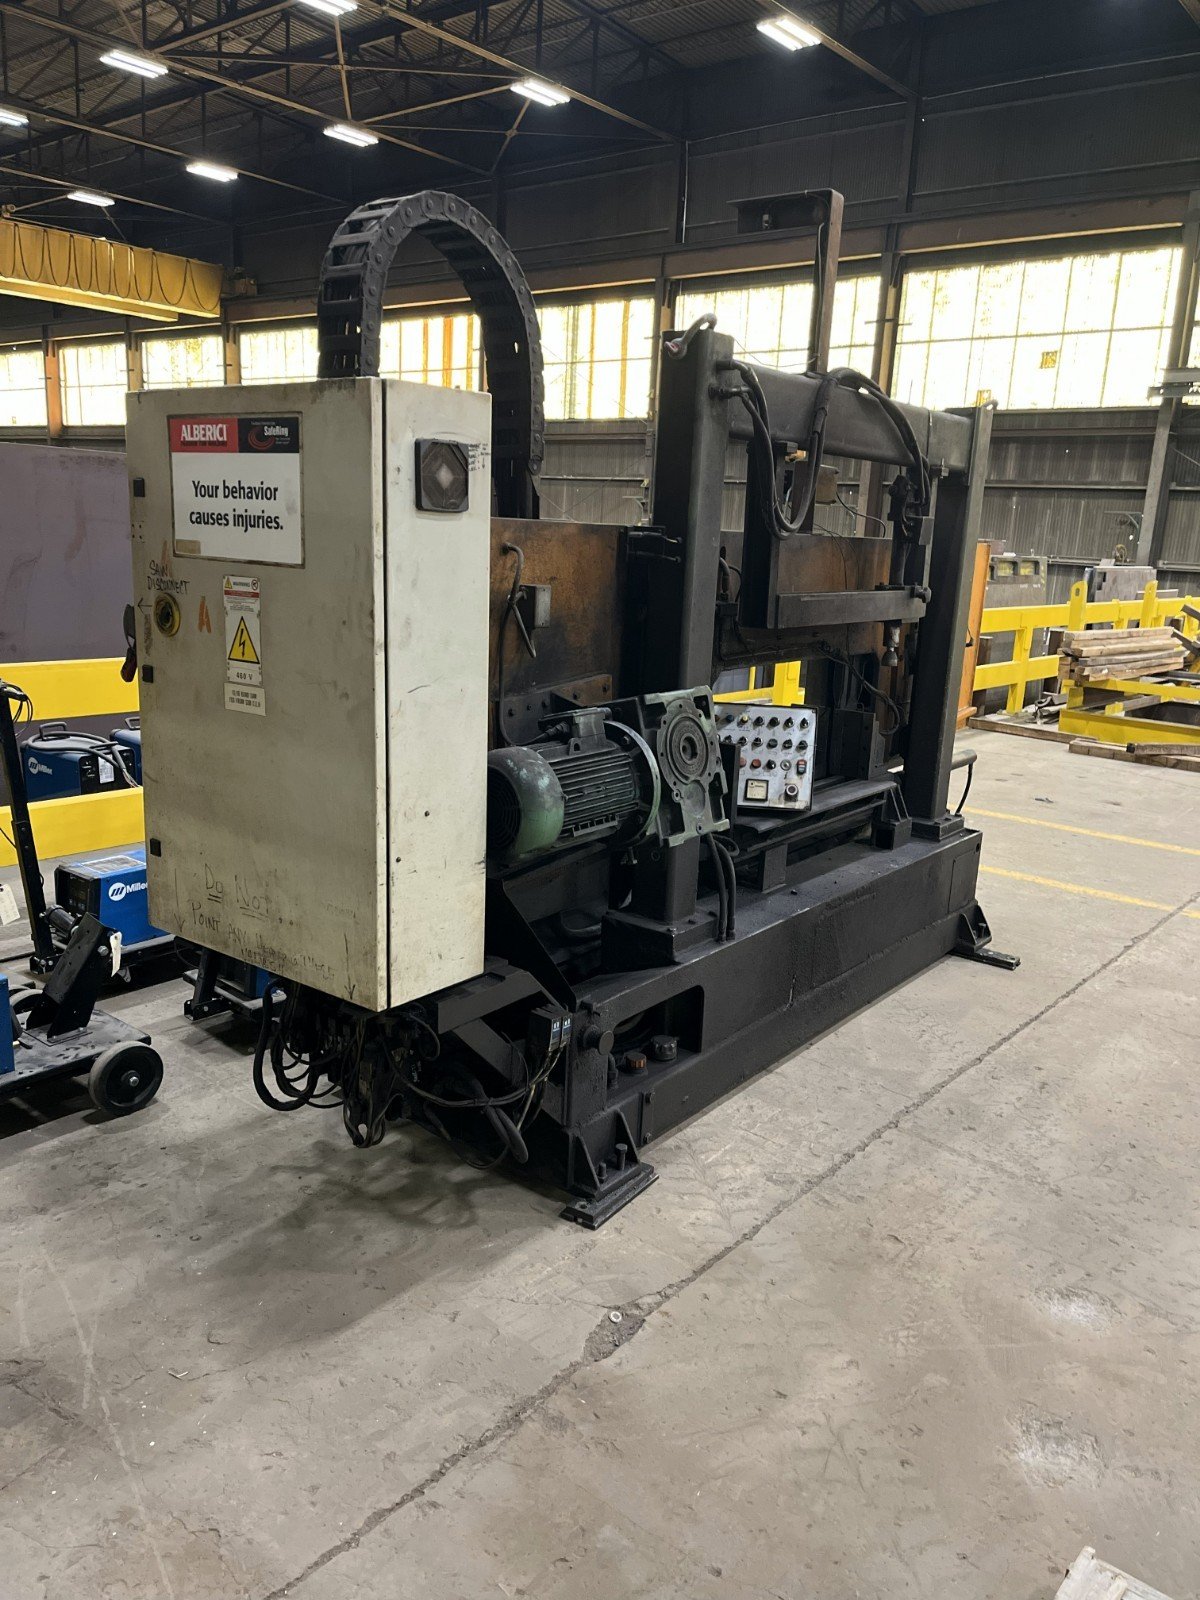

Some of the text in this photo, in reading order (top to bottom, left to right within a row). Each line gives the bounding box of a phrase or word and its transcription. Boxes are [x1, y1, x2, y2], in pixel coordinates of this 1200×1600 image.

[181, 424, 227, 441] ALBERICI
[192, 480, 278, 500] Your behavior
[189, 508, 283, 533] causes injuries.
